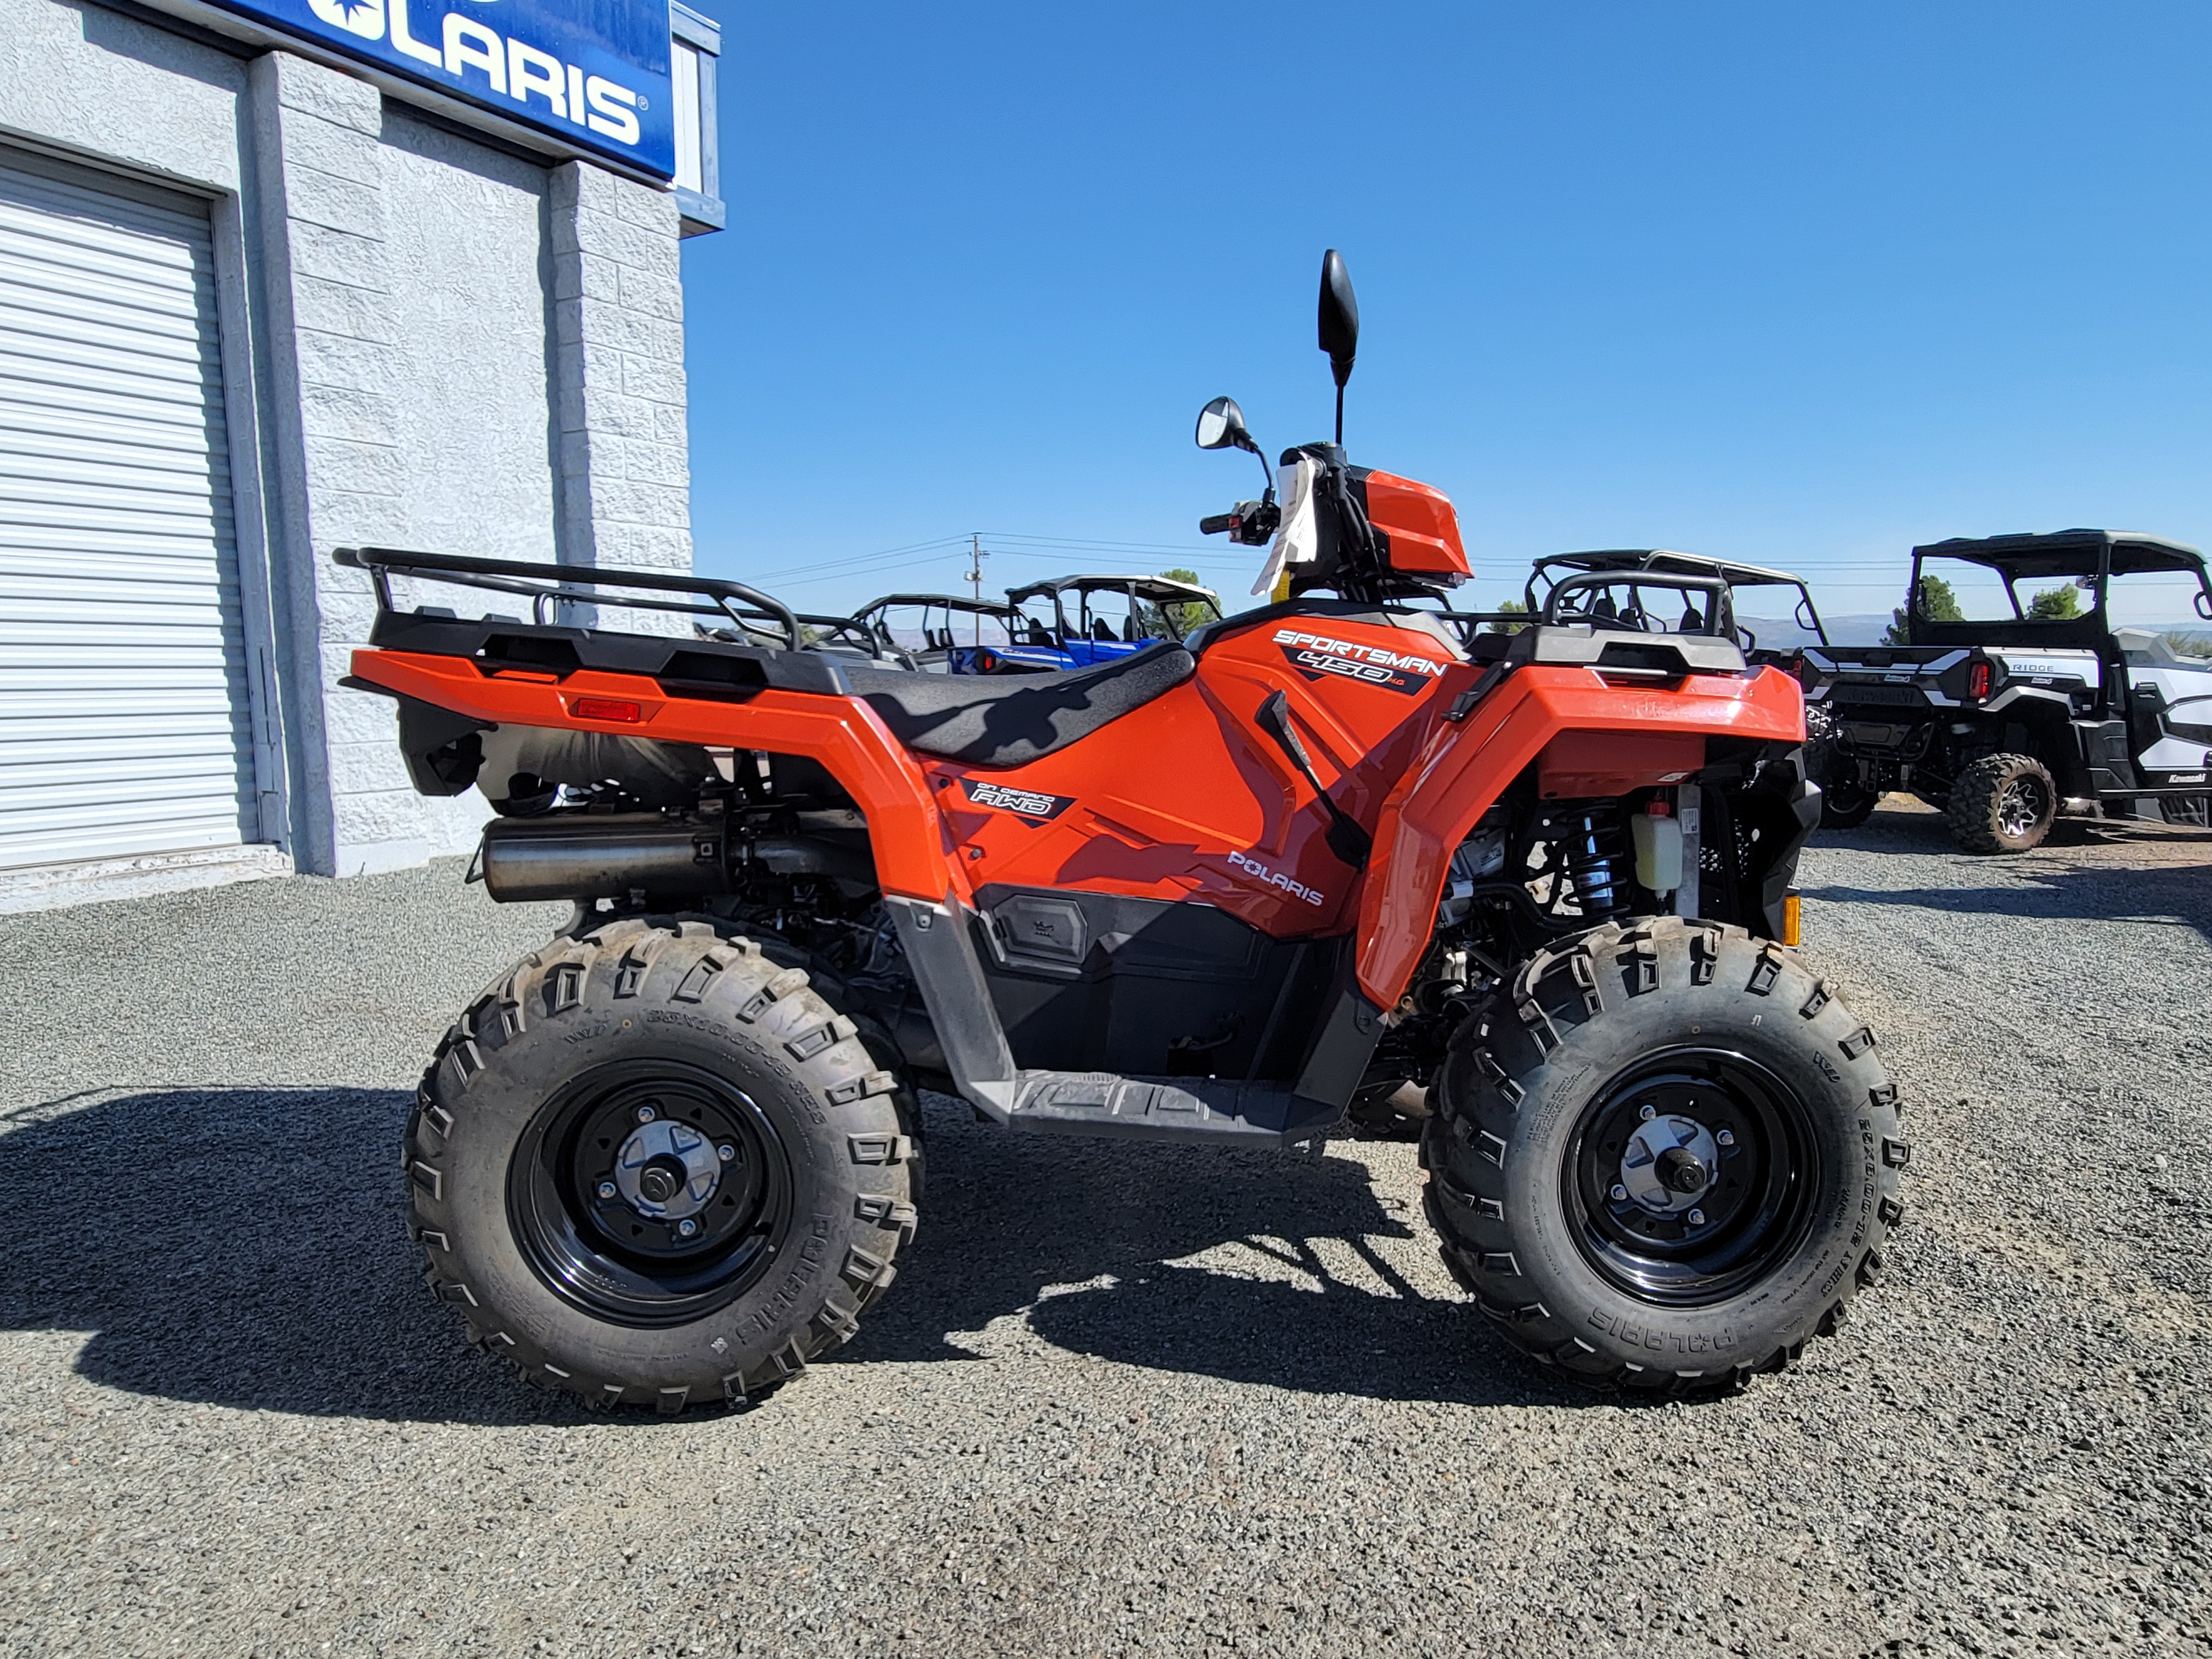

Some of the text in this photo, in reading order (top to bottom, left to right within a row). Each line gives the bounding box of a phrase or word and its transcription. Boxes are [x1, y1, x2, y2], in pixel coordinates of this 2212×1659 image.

[1272, 629, 1449, 677] SPORTSMAN
[1297, 651, 1394, 683] 450
[2013, 664, 2055, 672] RIDGE
[969, 788, 1052, 815] AWD
[977, 782, 1056, 803] ON DEMAND
[1227, 850, 1324, 906] POLARIS
[735, 1212, 833, 1346] POLARIS
[1587, 1306, 1738, 1354] POLARIS
